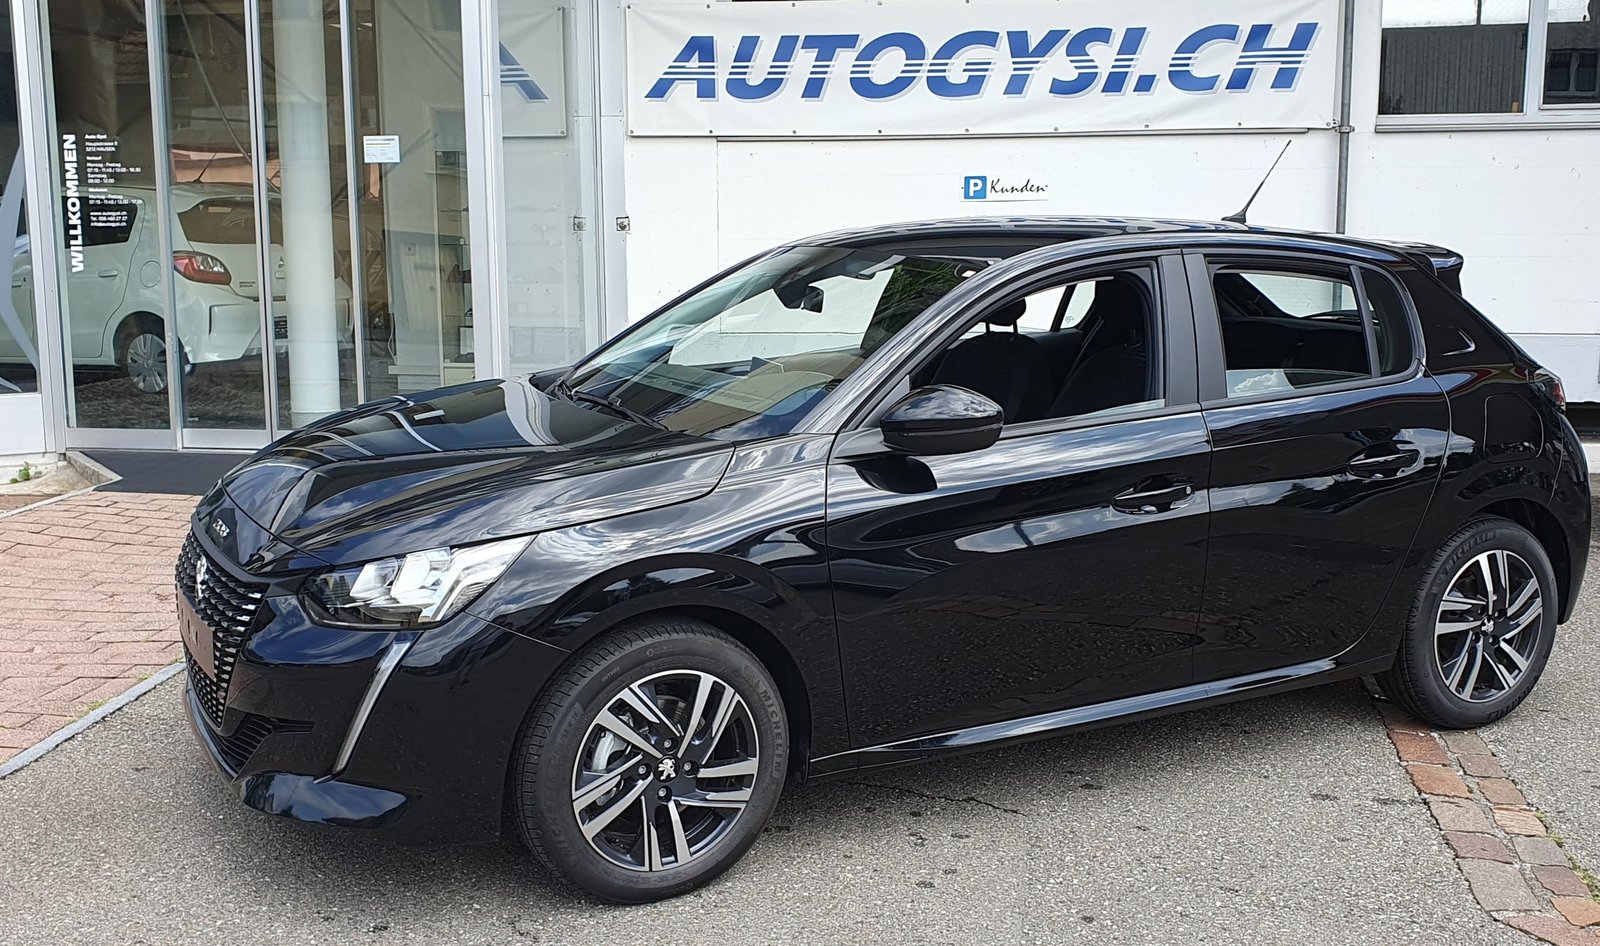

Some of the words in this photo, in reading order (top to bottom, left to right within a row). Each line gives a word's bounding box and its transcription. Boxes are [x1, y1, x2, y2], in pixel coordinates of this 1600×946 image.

[645, 22, 1319, 100] AUTOGYSI.CH
[63, 134, 84, 273] WILLKOMMEN
[990, 178, 1045, 193] Kunden
[1445, 531, 1497, 574] MICHELIN
[760, 689, 783, 772] MICHELIN
